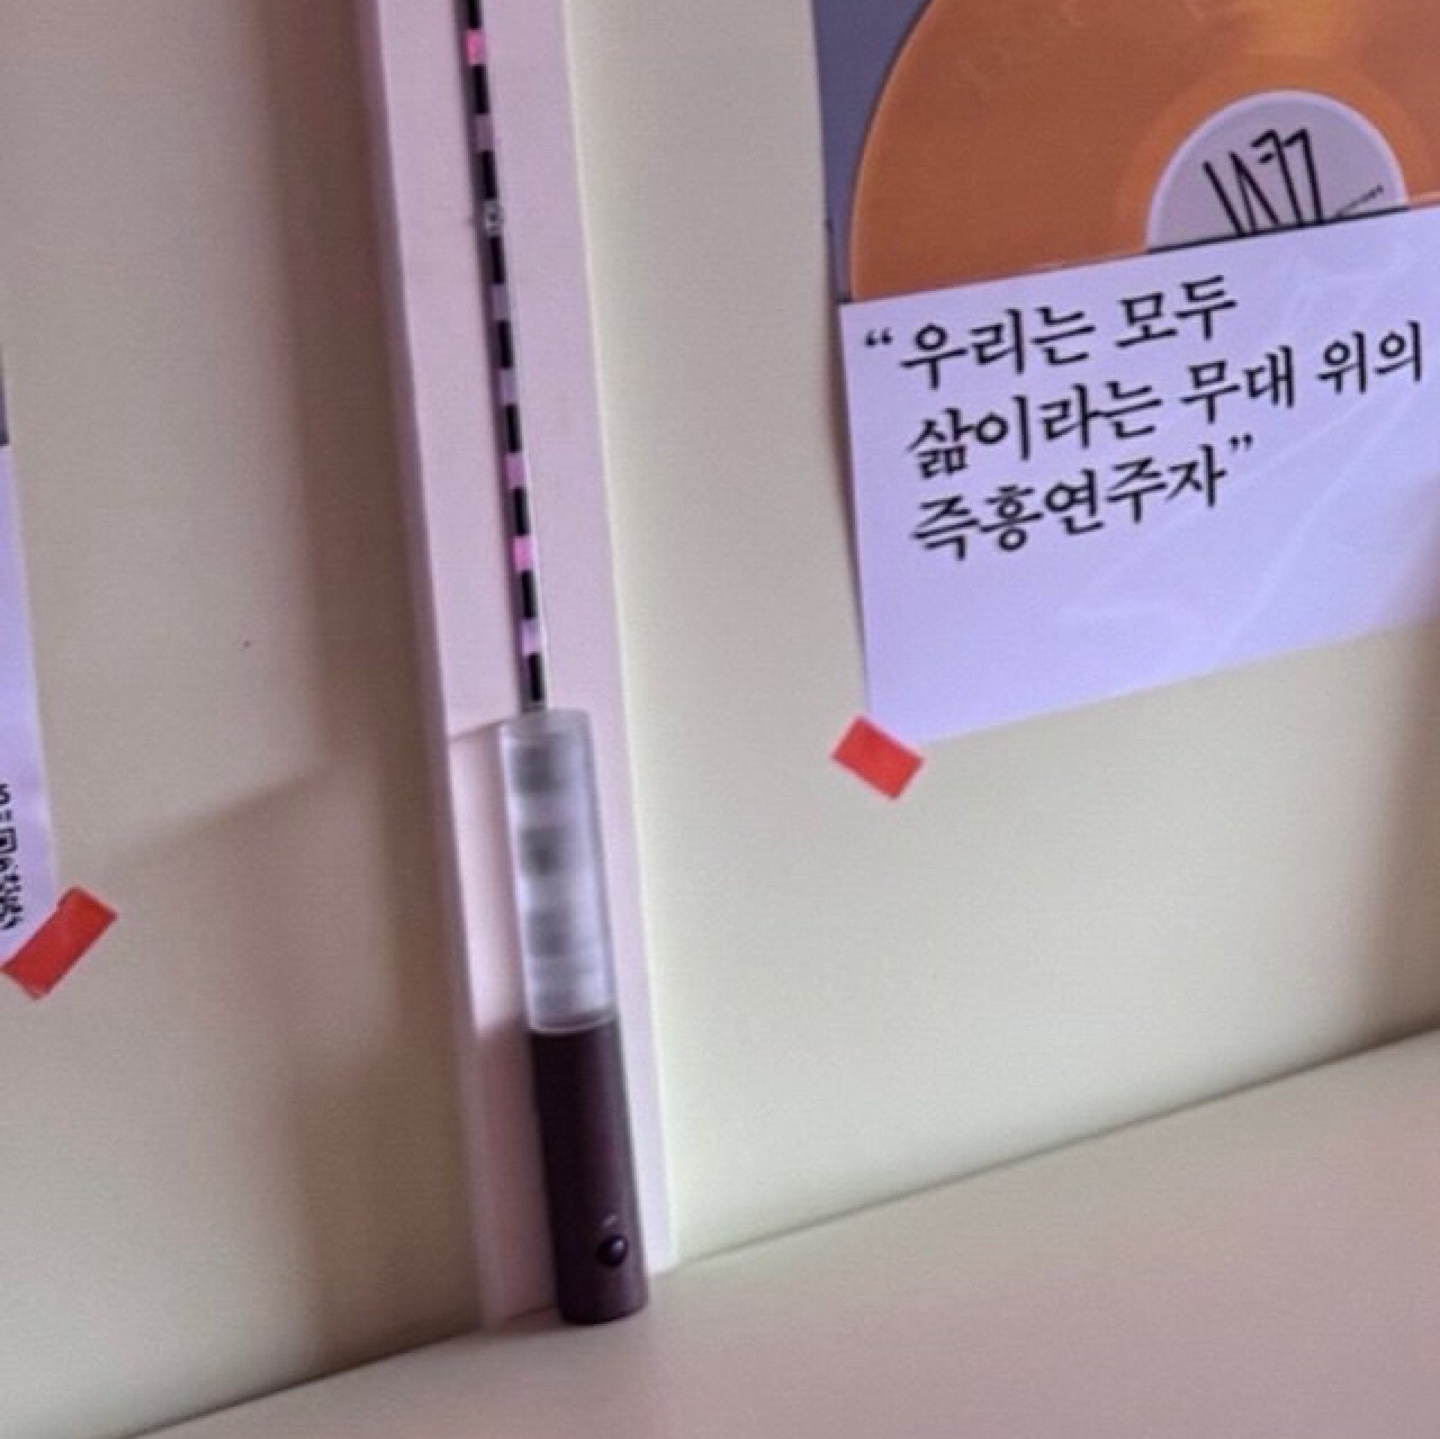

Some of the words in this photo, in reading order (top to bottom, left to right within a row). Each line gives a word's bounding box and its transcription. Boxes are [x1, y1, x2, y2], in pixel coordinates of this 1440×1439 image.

[1116, 275, 1239, 351] 모두
[906, 380, 1164, 479] 삶이라는
[1179, 346, 1297, 427] 무대
[1316, 320, 1426, 395] 위의
[908, 433, 1255, 562] 즉흥연주자”
